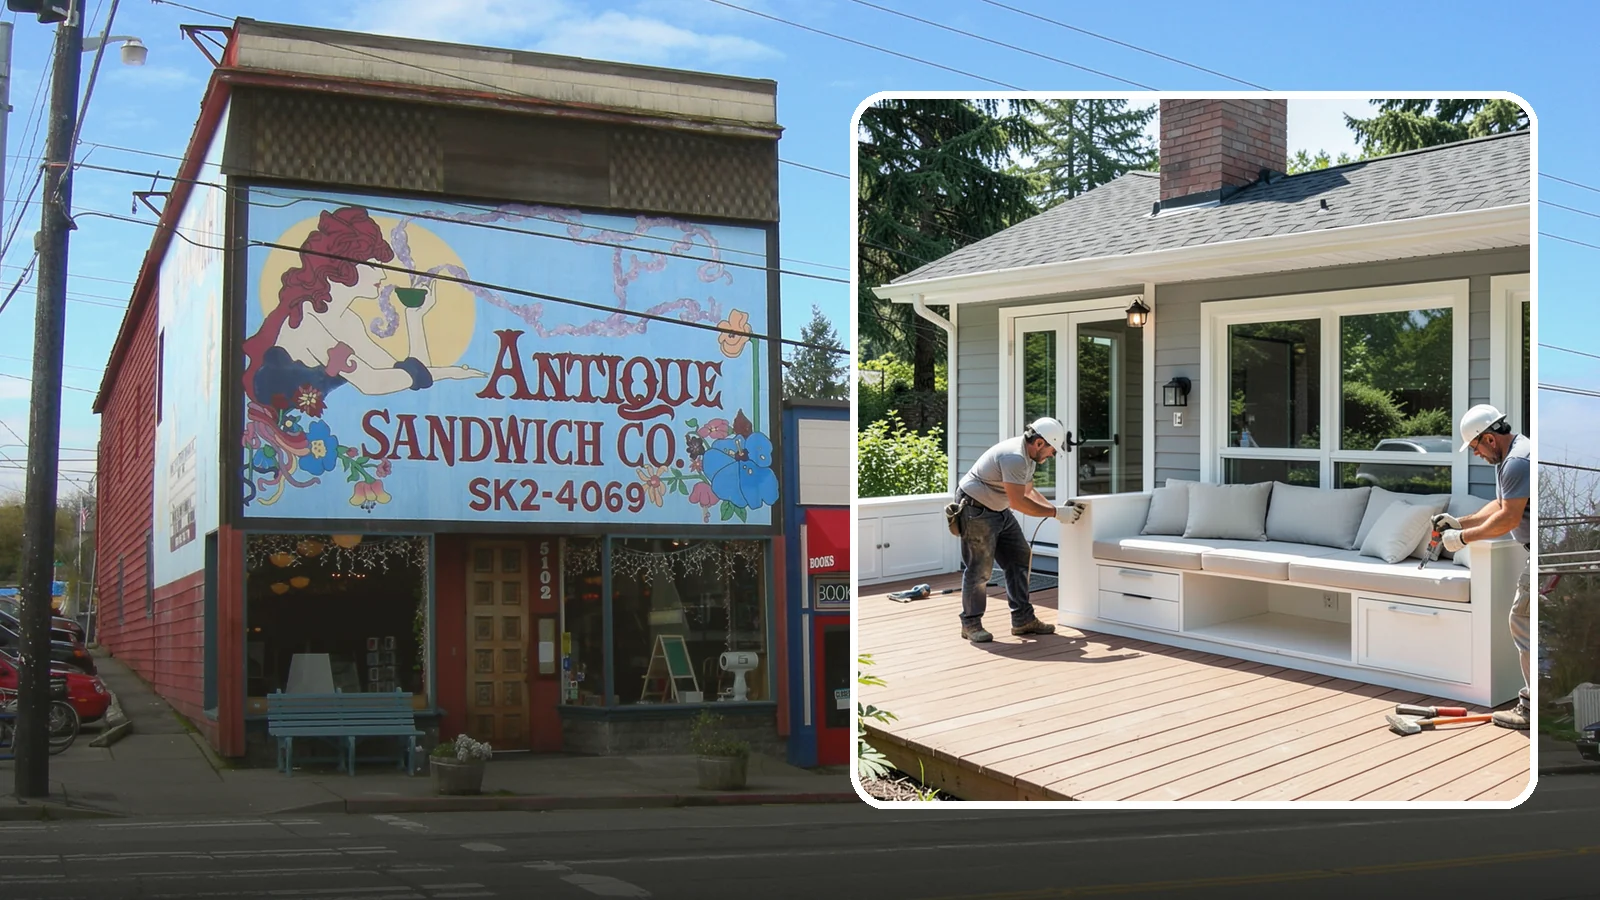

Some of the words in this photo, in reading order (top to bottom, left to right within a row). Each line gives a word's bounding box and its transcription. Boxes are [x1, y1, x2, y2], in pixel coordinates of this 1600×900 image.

[476, 329, 723, 420] ANTIQUE
[362, 409, 604, 466] SANDWICH
[618, 421, 686, 469] CO.
[468, 478, 646, 512] SK2-4069
[540, 542, 551, 599] 5102
[809, 555, 835, 569] BOOKS
